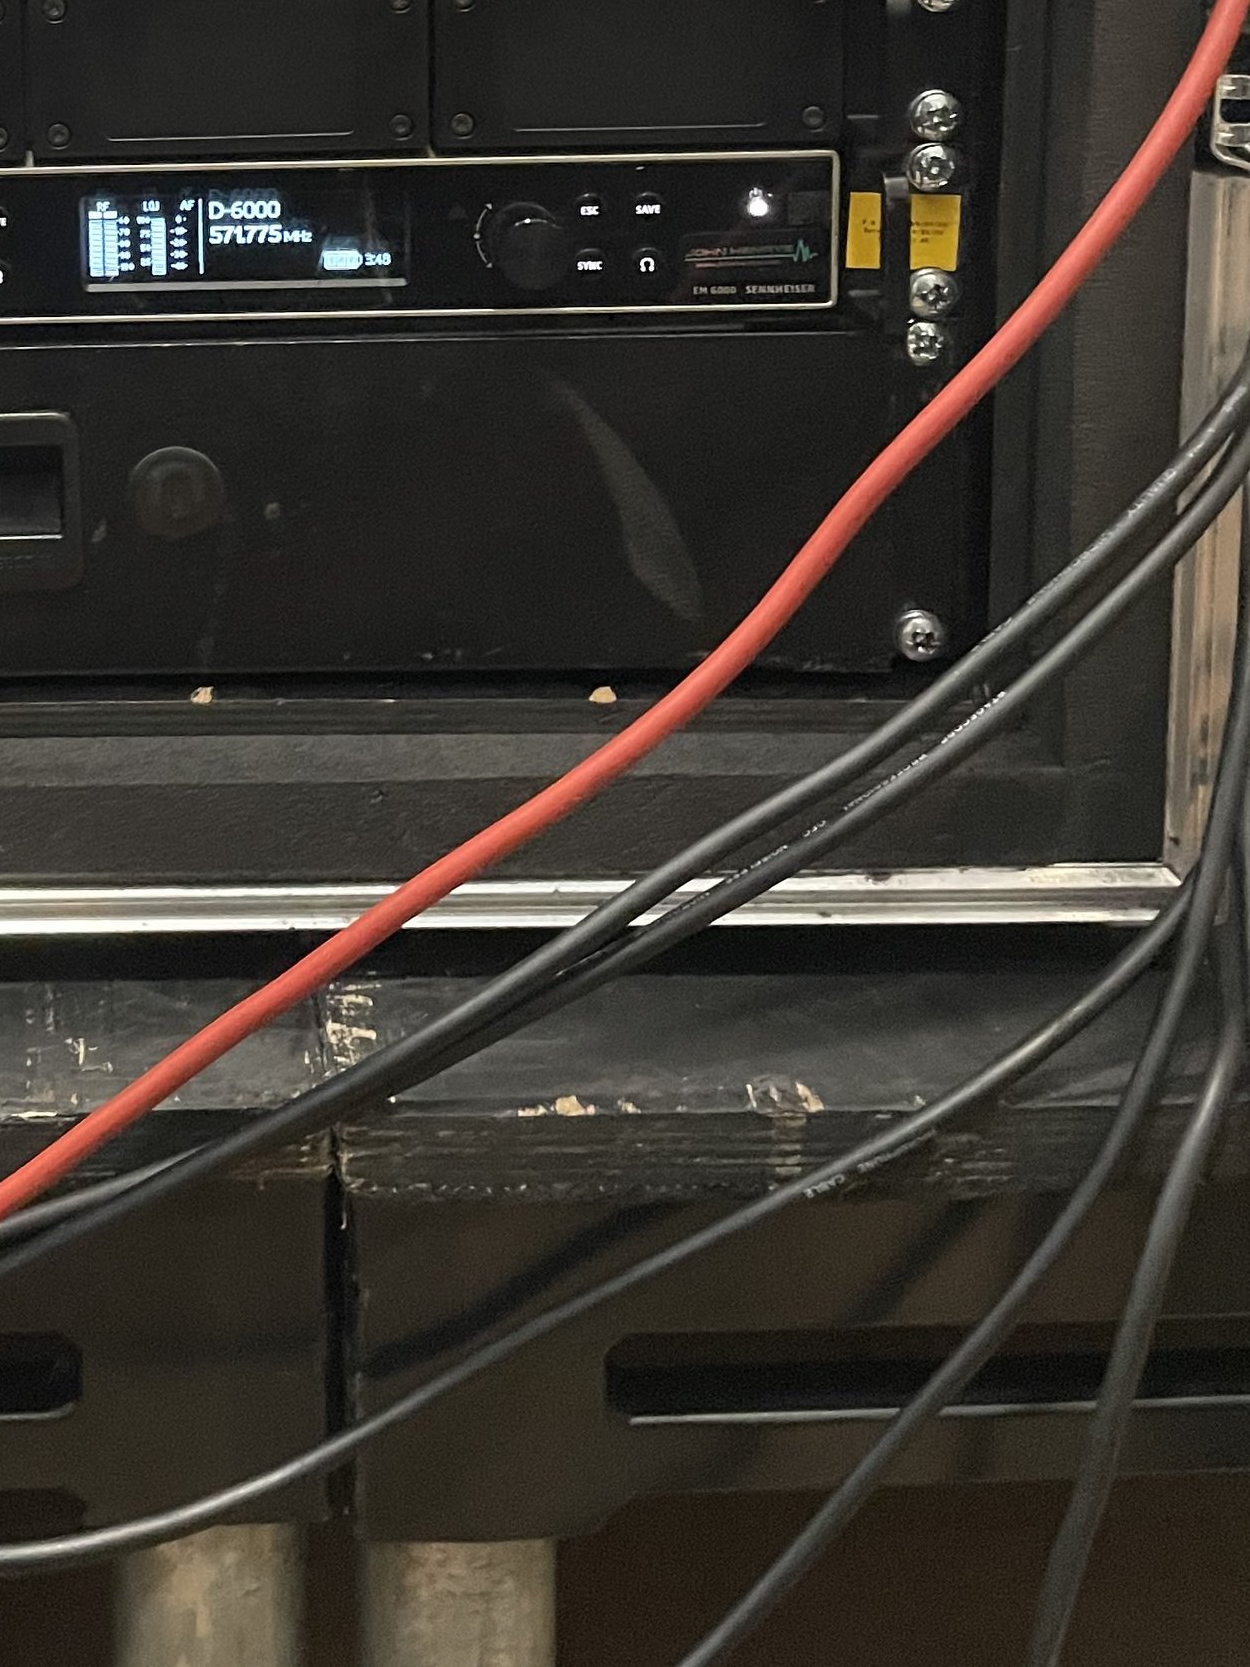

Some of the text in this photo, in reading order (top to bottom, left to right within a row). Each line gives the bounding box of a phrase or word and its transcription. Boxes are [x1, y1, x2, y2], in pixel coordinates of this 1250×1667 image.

[179, 199, 196, 211] AF
[207, 200, 281, 221] D-6000
[580, 204, 661, 216] ESC SAVE
[576, 260, 603, 271] SYNC
[693, 286, 708, 295] EM
